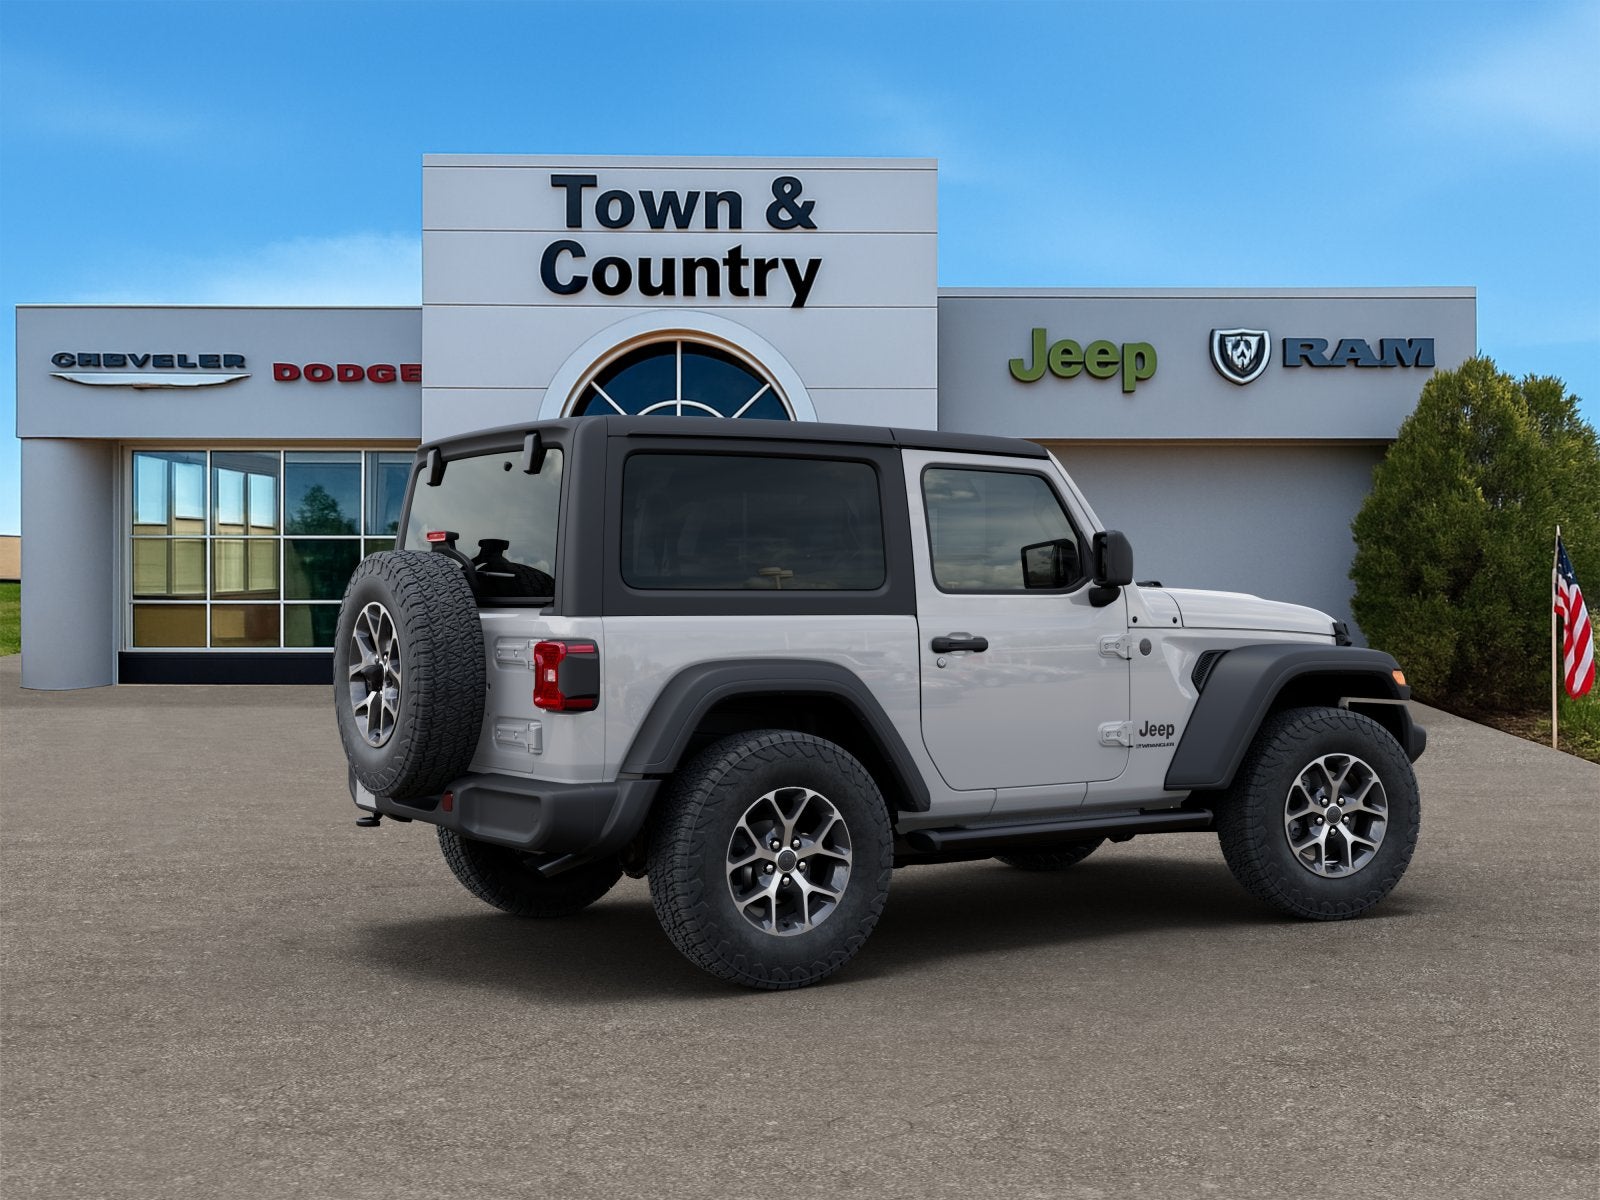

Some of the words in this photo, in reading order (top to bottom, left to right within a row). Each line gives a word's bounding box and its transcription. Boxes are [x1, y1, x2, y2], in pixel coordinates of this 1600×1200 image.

[550, 174, 742, 229] Town
[766, 175, 818, 230] &
[540, 239, 822, 308] Country
[272, 362, 422, 384] DODGE
[1009, 328, 1157, 392] Jeep
[1282, 337, 1435, 368] RAM
[1139, 720, 1174, 739] Jeep
